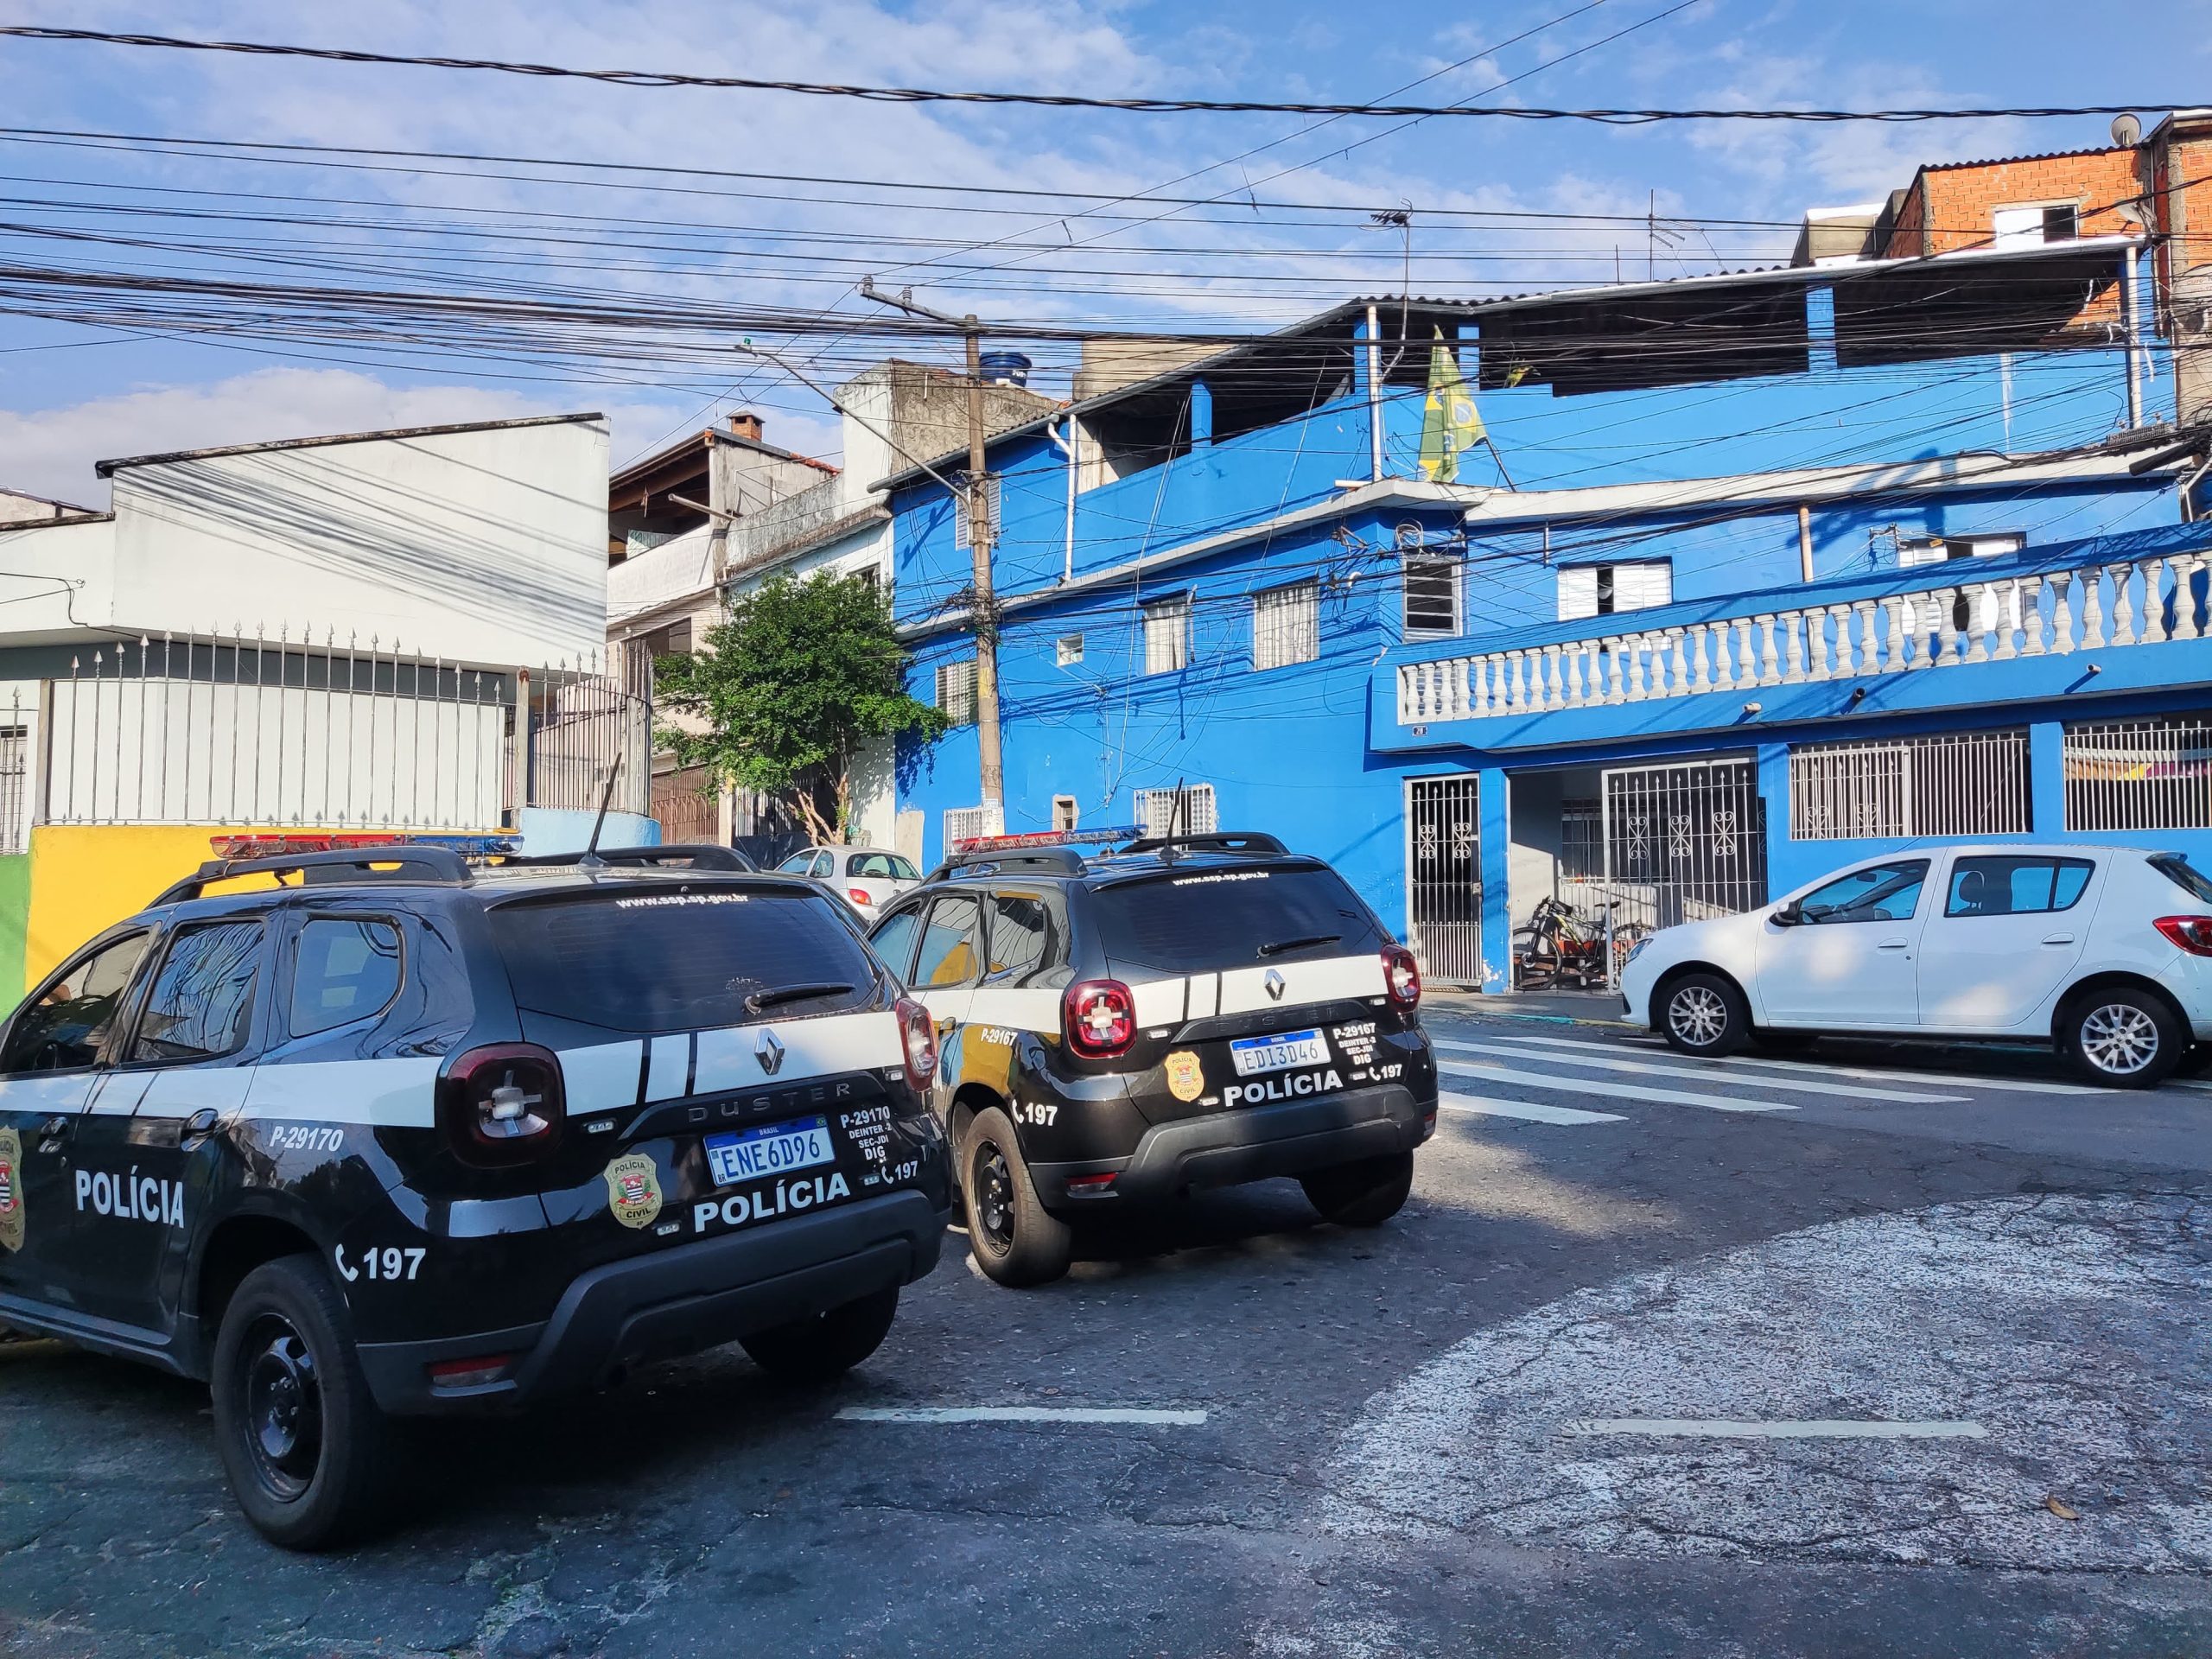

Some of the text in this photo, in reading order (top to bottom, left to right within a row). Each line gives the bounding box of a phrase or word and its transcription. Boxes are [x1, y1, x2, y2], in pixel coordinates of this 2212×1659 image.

[1173, 872, 1269, 886] www.ssp.sp.gov.br
[616, 893, 749, 908] www.ssp.sp.gov.br
[981, 1027, 1018, 1046] P-29167
[1332, 1022, 1376, 1039] P-29167
[1338, 1037, 1369, 1048] DEINTER
[1346, 1045, 1373, 1055] SEC-JDI
[1244, 1041, 1319, 1070] EDI3D46
[1353, 1053, 1371, 1065] DIG
[1381, 1064, 1402, 1078] 197
[1224, 1070, 1344, 1107] POLÍCIA
[688, 1083, 851, 1122] DUSTER
[840, 1106, 890, 1128] P-29170
[1025, 1103, 1058, 1127] 197
[269, 1126, 344, 1152] P-29170
[759, 1127, 779, 1135] BRASIL
[849, 1124, 883, 1139] DEINTER
[858, 1135, 889, 1148] SEC-JDI
[721, 1133, 820, 1178] ENE6D96
[864, 1146, 885, 1160] DIG
[614, 1160, 645, 1174] POLÍCIA
[895, 1160, 918, 1180] 197
[75, 1165, 185, 1229] POLÍCIA
[694, 1172, 850, 1233] POLÍCIA
[626, 1208, 652, 1218] CIVIL
[363, 1247, 426, 1280] 197
